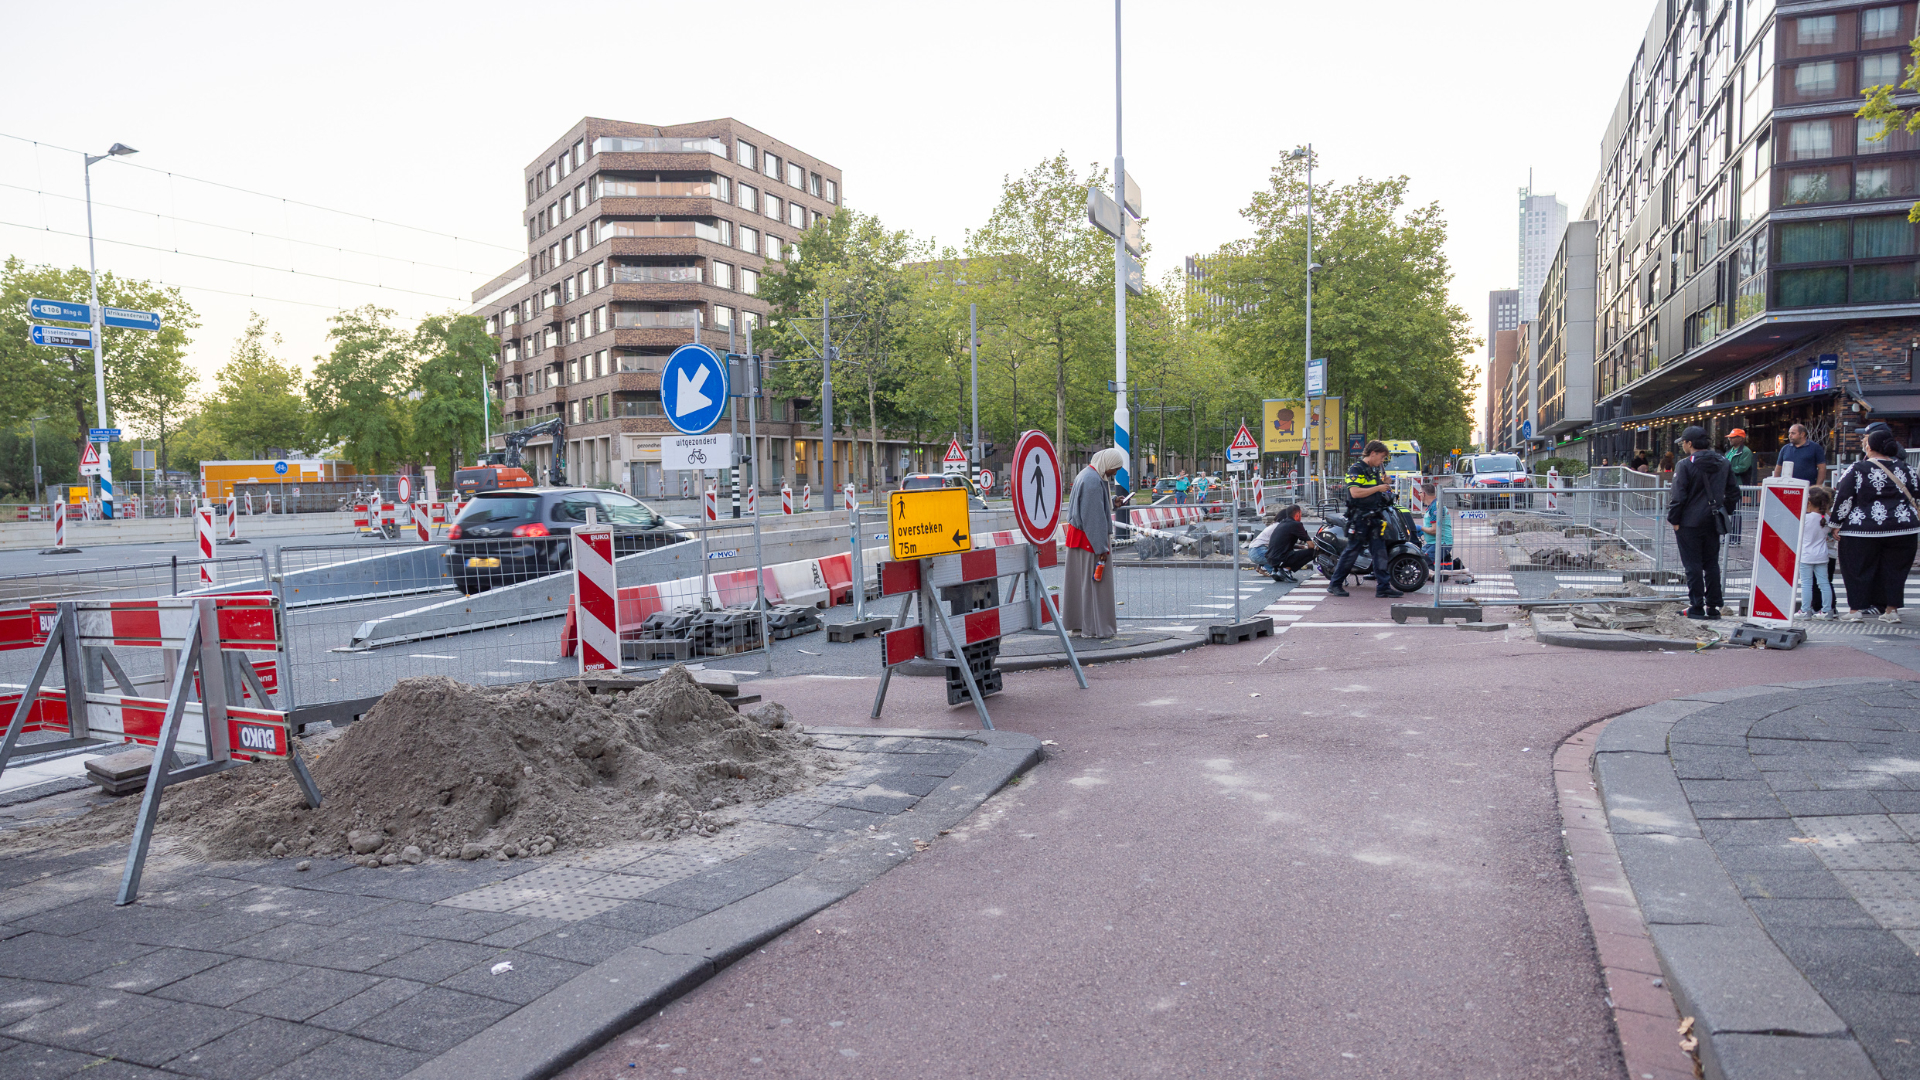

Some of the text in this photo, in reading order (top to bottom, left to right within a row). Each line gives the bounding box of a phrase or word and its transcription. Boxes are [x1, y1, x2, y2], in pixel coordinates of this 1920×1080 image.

[63, 308, 77, 317] Ring
[107, 310, 150, 320] Afrikaanderwijk
[676, 437, 717, 448] uitgezonderd
[898, 522, 943, 537] oversteken
[898, 542, 917, 555] 75m
[39, 615, 58, 631] BUK
[257, 674, 273, 682] BUK
